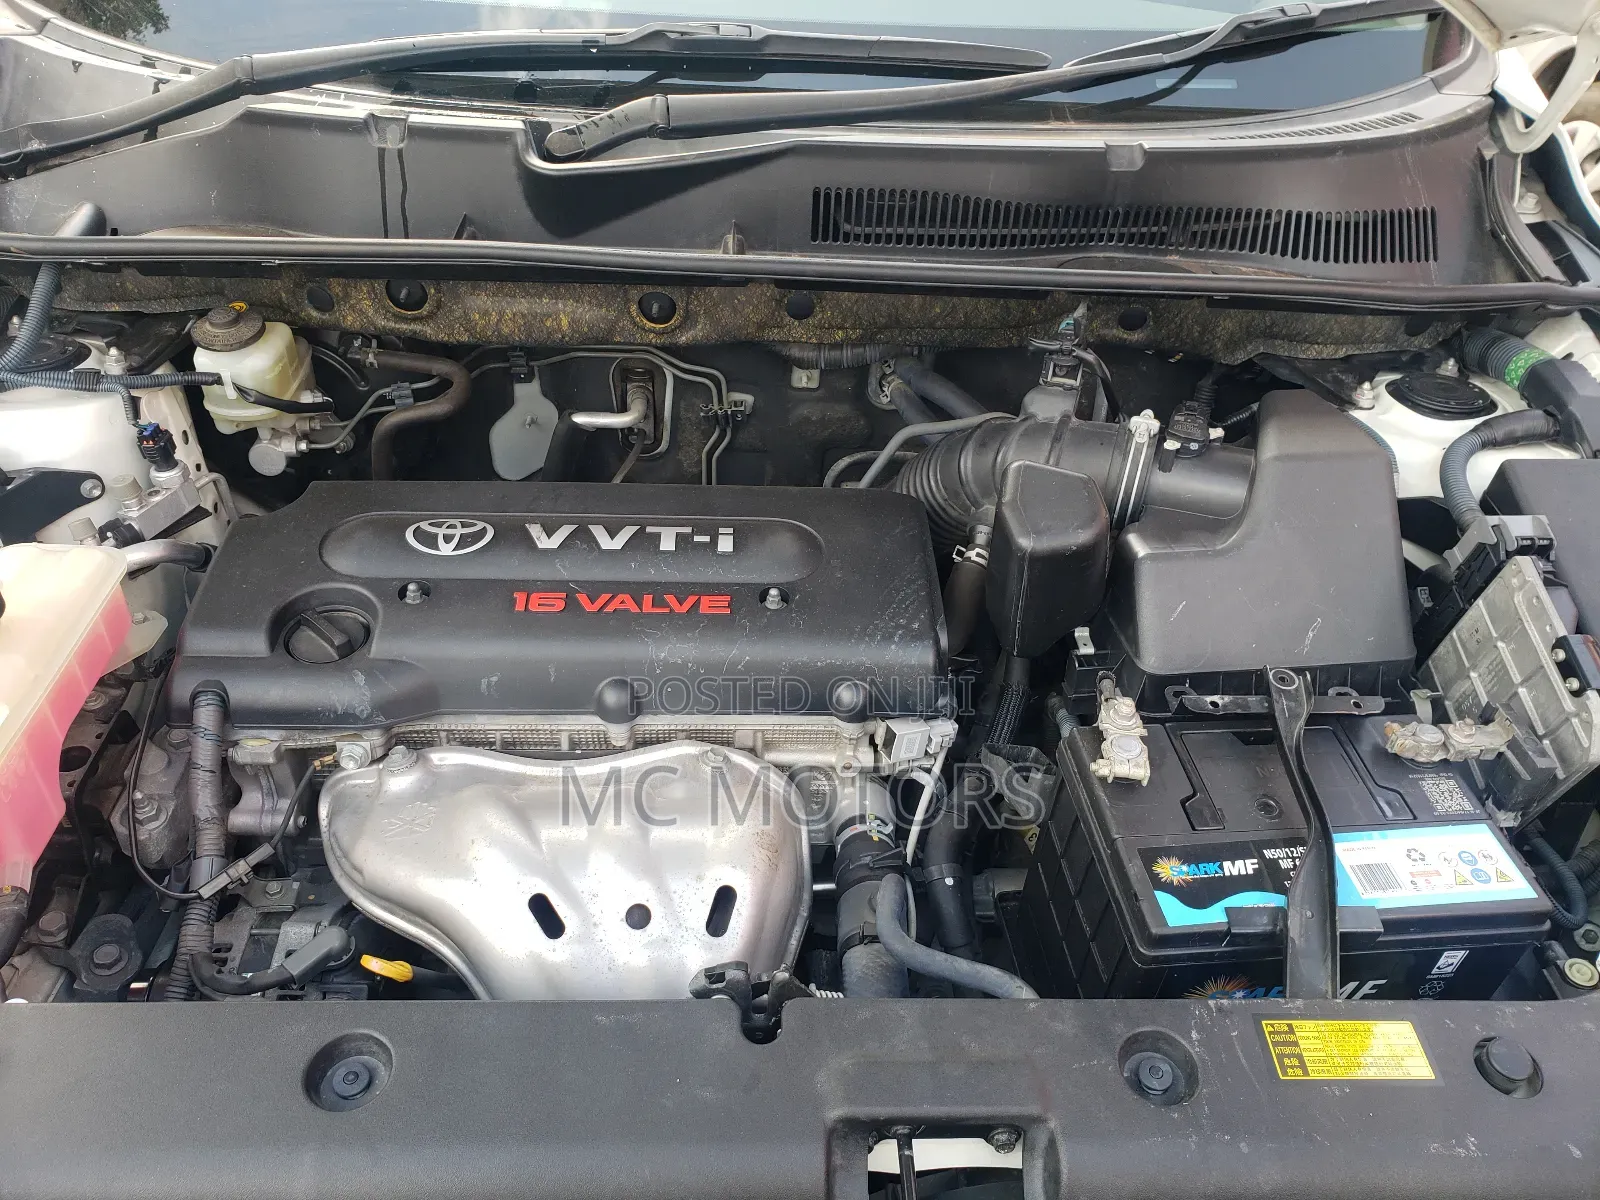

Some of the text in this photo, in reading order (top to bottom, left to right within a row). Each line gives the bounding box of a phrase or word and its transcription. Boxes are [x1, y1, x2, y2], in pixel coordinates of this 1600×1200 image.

[525, 523, 734, 552] VVT-i
[513, 591, 731, 614] 16 VALVE
[1262, 845, 1307, 859] N50/12/S
[1169, 858, 1259, 877] SPARK MF
[1278, 858, 1294, 869] MF
[1270, 1034, 1297, 1042] CAUTION
[1274, 1046, 1301, 1054] ATTENTION
